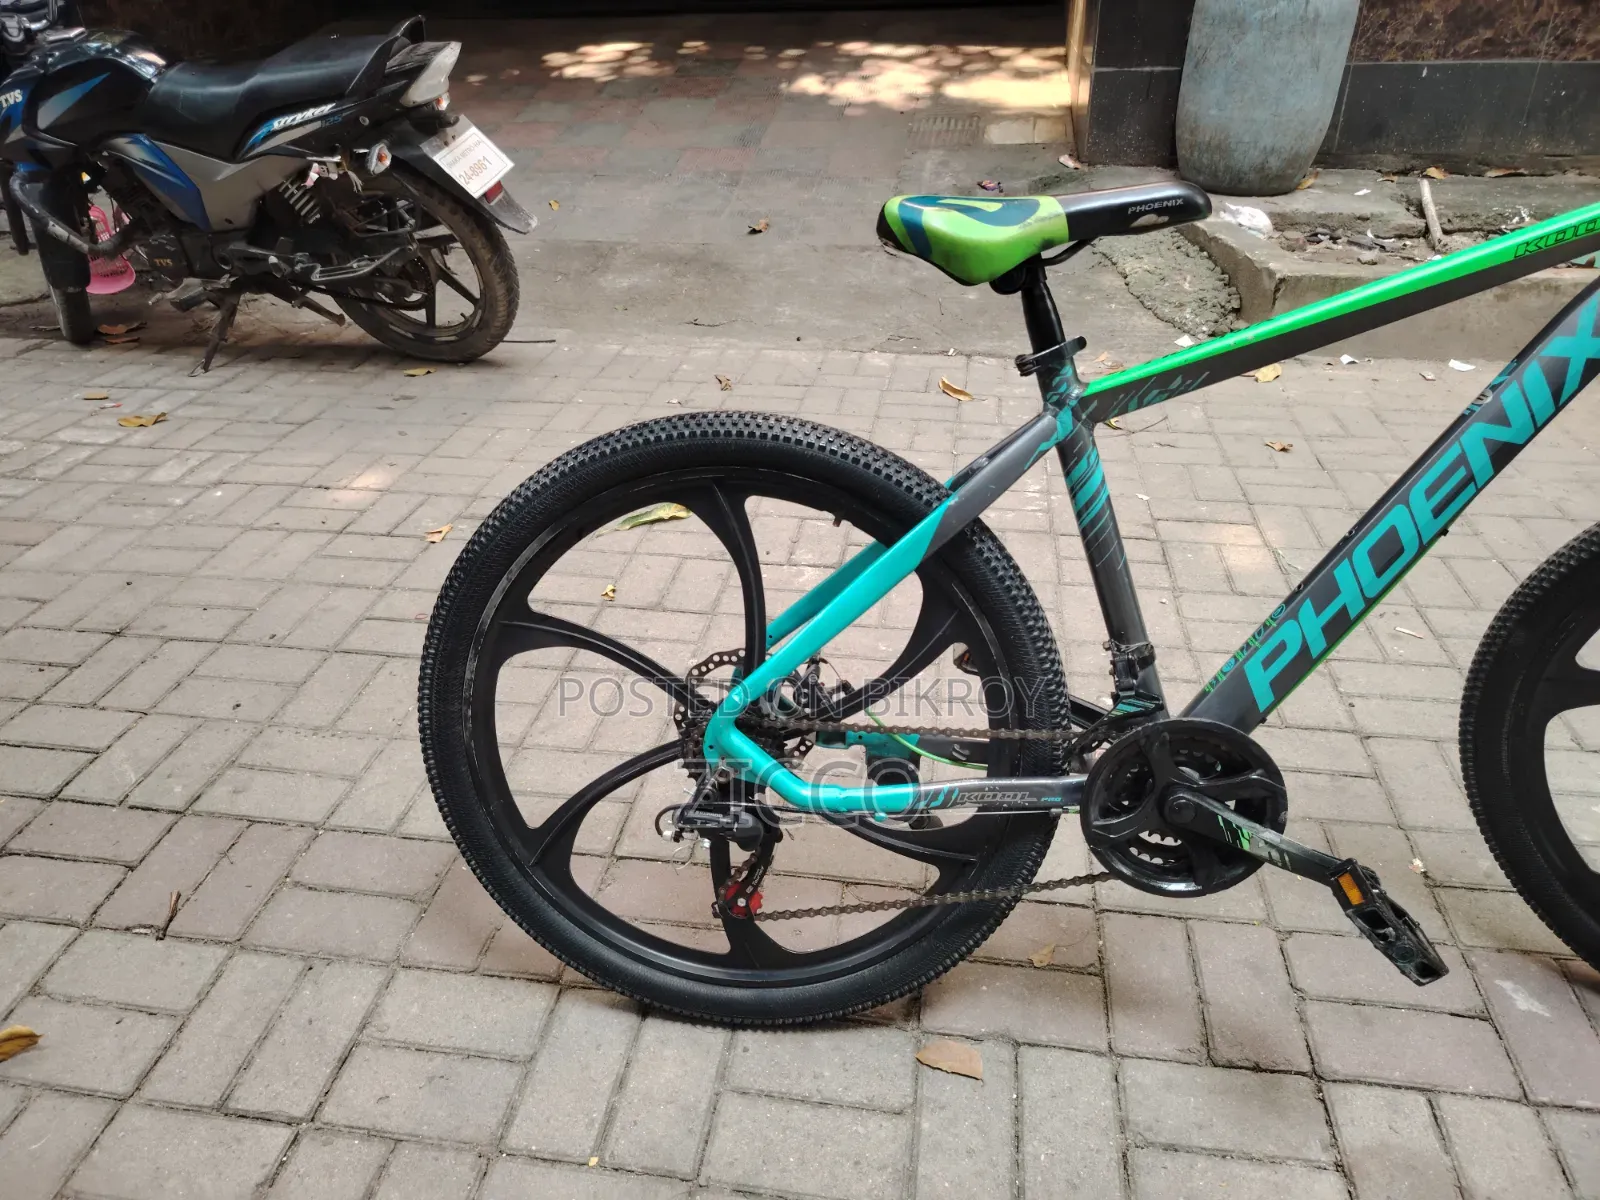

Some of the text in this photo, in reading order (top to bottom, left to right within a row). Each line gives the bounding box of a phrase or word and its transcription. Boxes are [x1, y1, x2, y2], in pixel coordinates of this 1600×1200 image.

[0, 89, 23, 107] TVS
[459, 155, 493, 186] 24-8961
[1127, 198, 1184, 215] PHOENIX
[153, 258, 173, 267] TVS
[1243, 289, 1600, 713] PHOENIX
[957, 791, 1038, 803] KOOL
